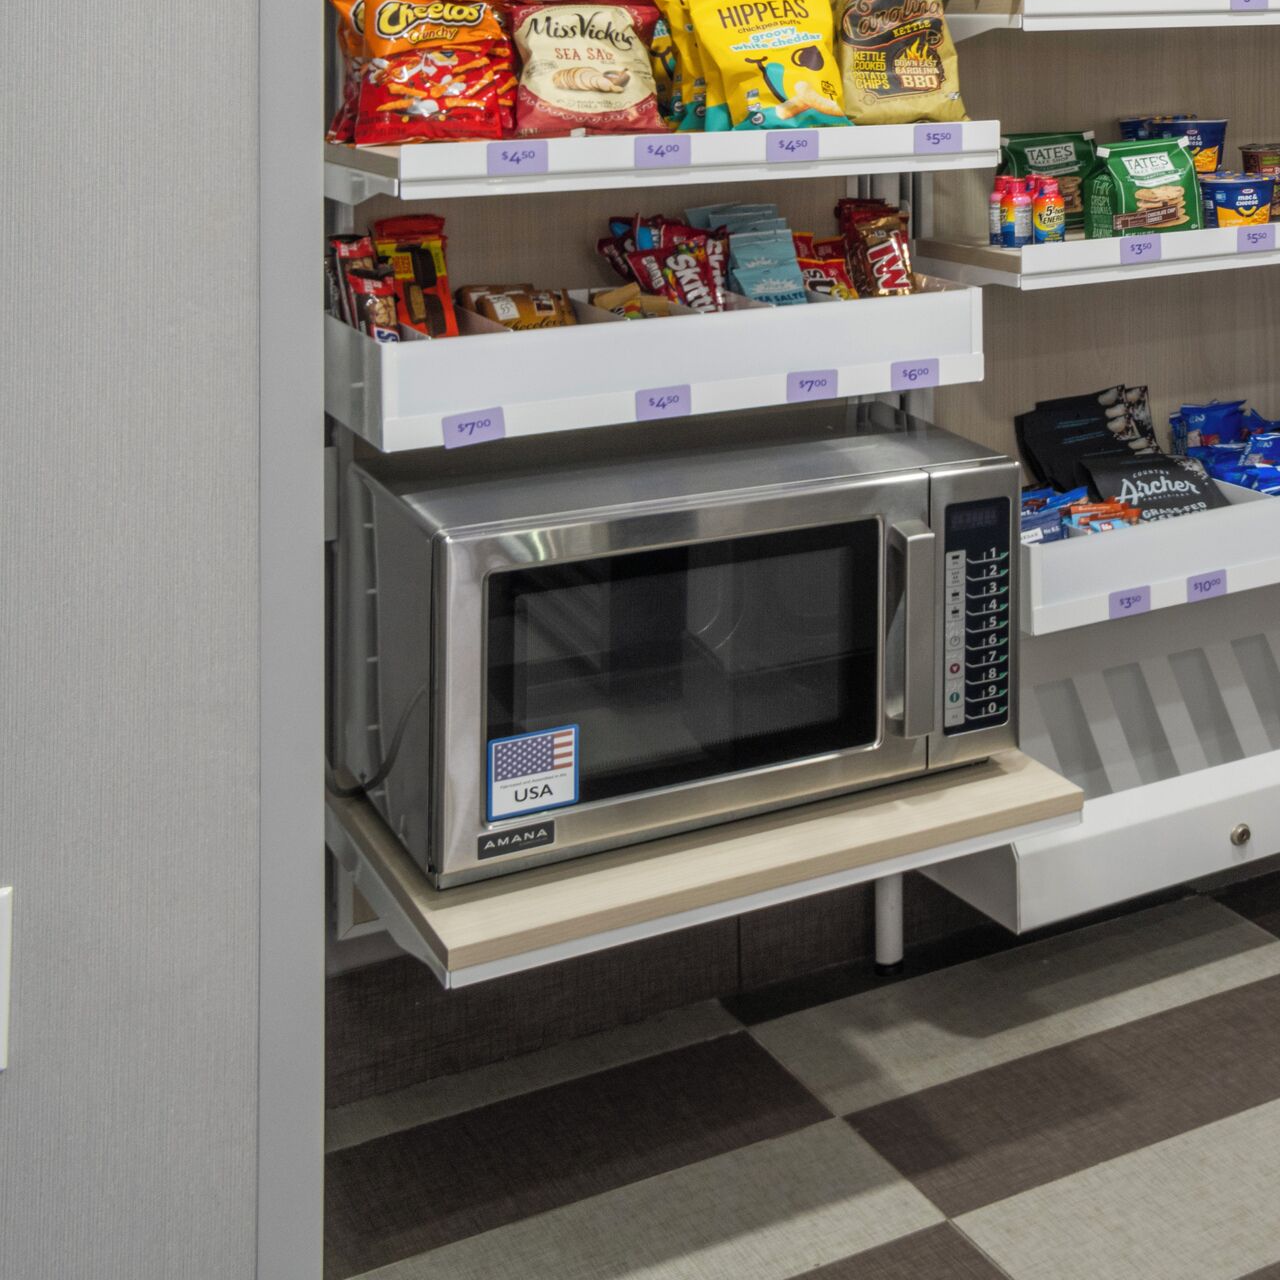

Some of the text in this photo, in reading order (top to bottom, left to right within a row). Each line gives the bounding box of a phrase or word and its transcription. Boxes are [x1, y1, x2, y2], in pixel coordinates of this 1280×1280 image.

[376, 0, 486, 39] Cheetos
[716, 0, 810, 30] HIPPEAS
[407, 25, 459, 43] Crunchy
[737, 21, 778, 35] chickpea
[892, 20, 932, 39] KETTLE
[751, 26, 798, 44] groovy
[730, 32, 822, 52] white cheddar
[554, 48, 582, 61] SEA
[853, 50, 887, 62] KETTLE
[853, 60, 887, 72] COOKED
[895, 66, 940, 76] CAROLINA
[853, 70, 888, 81] POTATO
[902, 74, 938, 89] BBQ
[855, 79, 890, 90] CHIPS
[1026, 144, 1075, 162] TATE'S
[1126, 154, 1170, 171] TATE'S
[1132, 468, 1170, 479] COUNTRY
[1115, 475, 1200, 506] Archer
[1142, 501, 1208, 519] GRASS-FED
[990, 547, 997, 558] 1
[989, 565, 997, 576] 2
[989, 582, 997, 593] 3
[989, 599, 997, 610] 4
[989, 617, 997, 627] 5
[989, 634, 997, 645] 6
[989, 651, 997, 661] 7
[989, 668, 997, 679] 8
[989, 685, 997, 697] 9
[989, 703, 997, 713] 0
[514, 784, 554, 803] USA
[483, 828, 548, 850] AMANA
